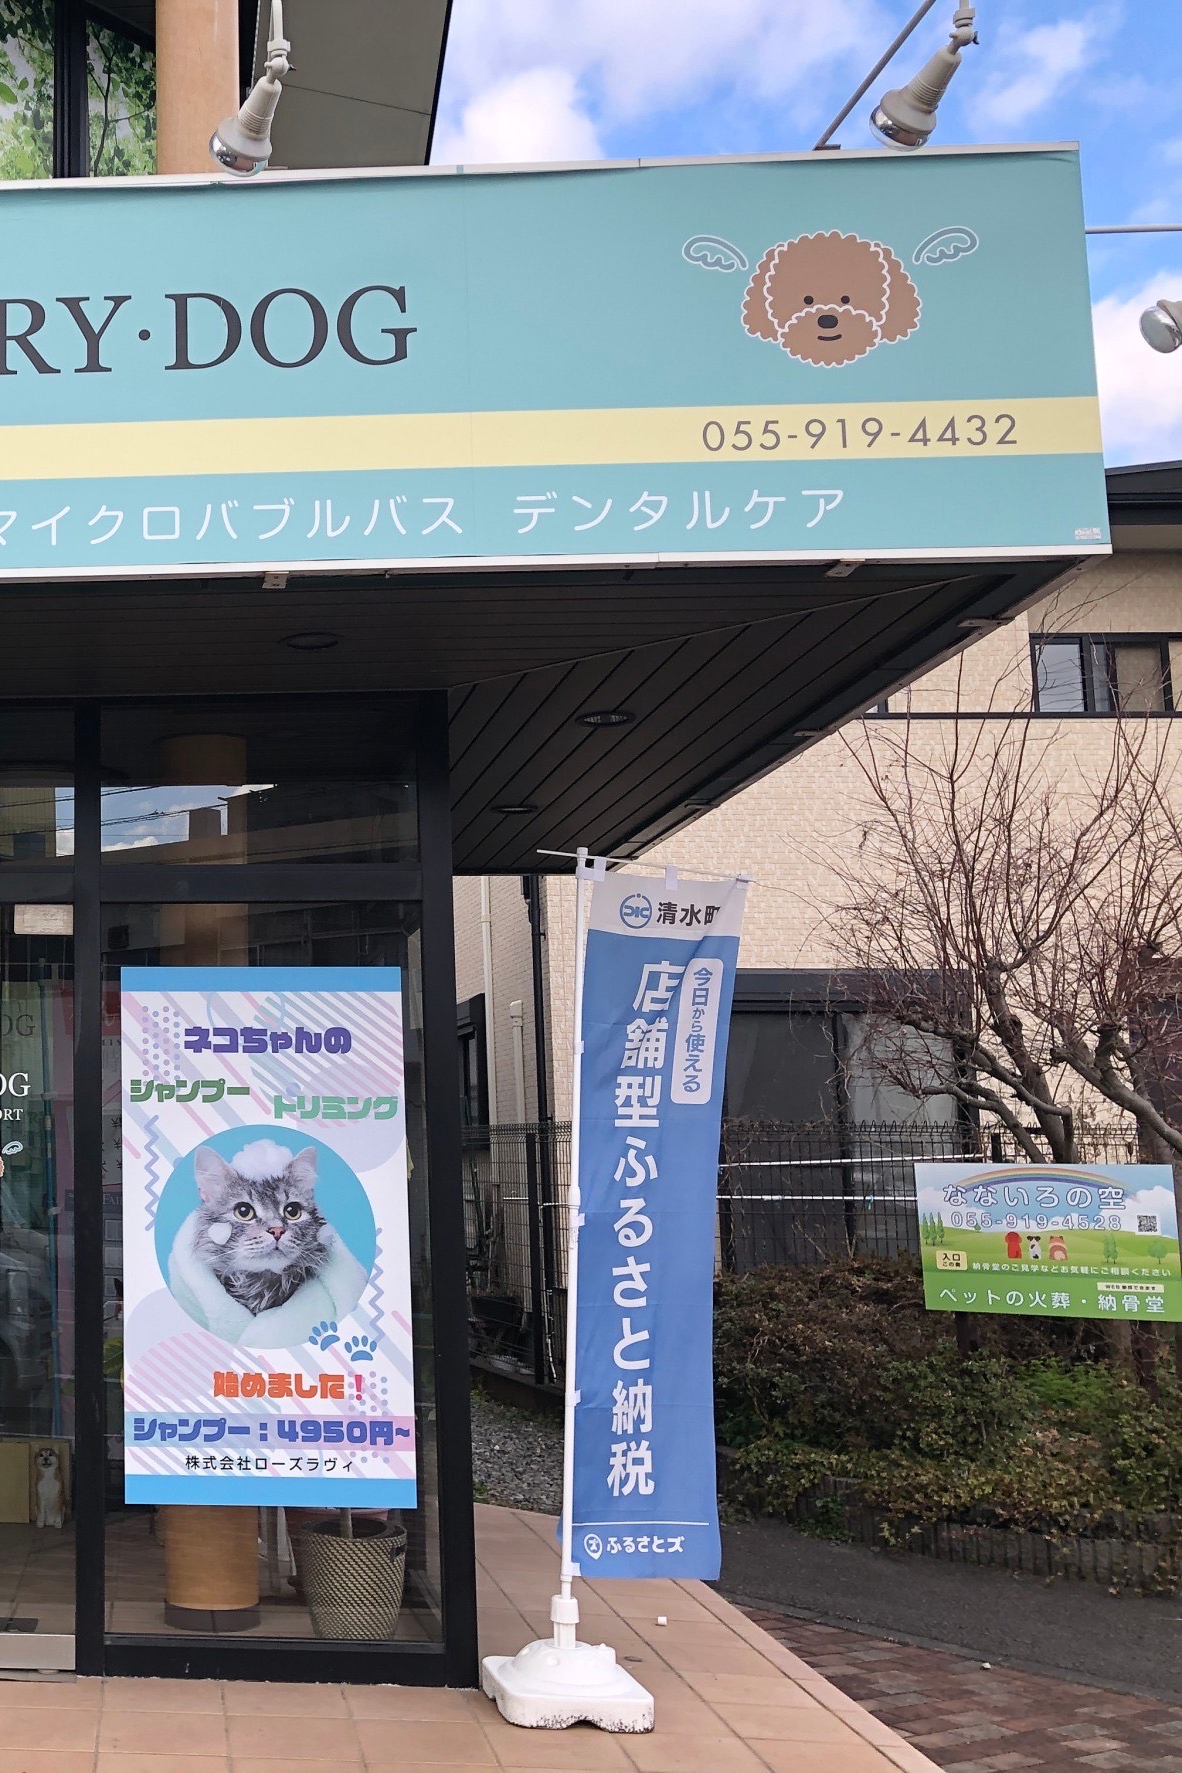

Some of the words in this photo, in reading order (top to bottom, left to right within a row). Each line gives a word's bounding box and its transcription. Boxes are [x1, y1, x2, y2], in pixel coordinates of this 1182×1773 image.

[702, 413, 1018, 452] 055-919-4432
[513, 488, 845, 533] デンタルケア
[656, 901, 721, 927] 清水町
[183, 1026, 352, 1055] ネコちゃんの
[682, 966, 713, 1093] 今日から使える
[129, 1078, 250, 1103] シャンプー
[273, 1095, 399, 1121] トリミング
[942, 1184, 1127, 1211] なないろの空
[606, 960, 686, 1497] 店舗型ふるさと納税
[950, 1211, 1122, 1231] 055-919-4528
[942, 1253, 961, 1261] 入口
[185, 1455, 354, 1473] 株式会社ローズラヴィ
[606, 1535, 686, 1554] ふるさとズ
